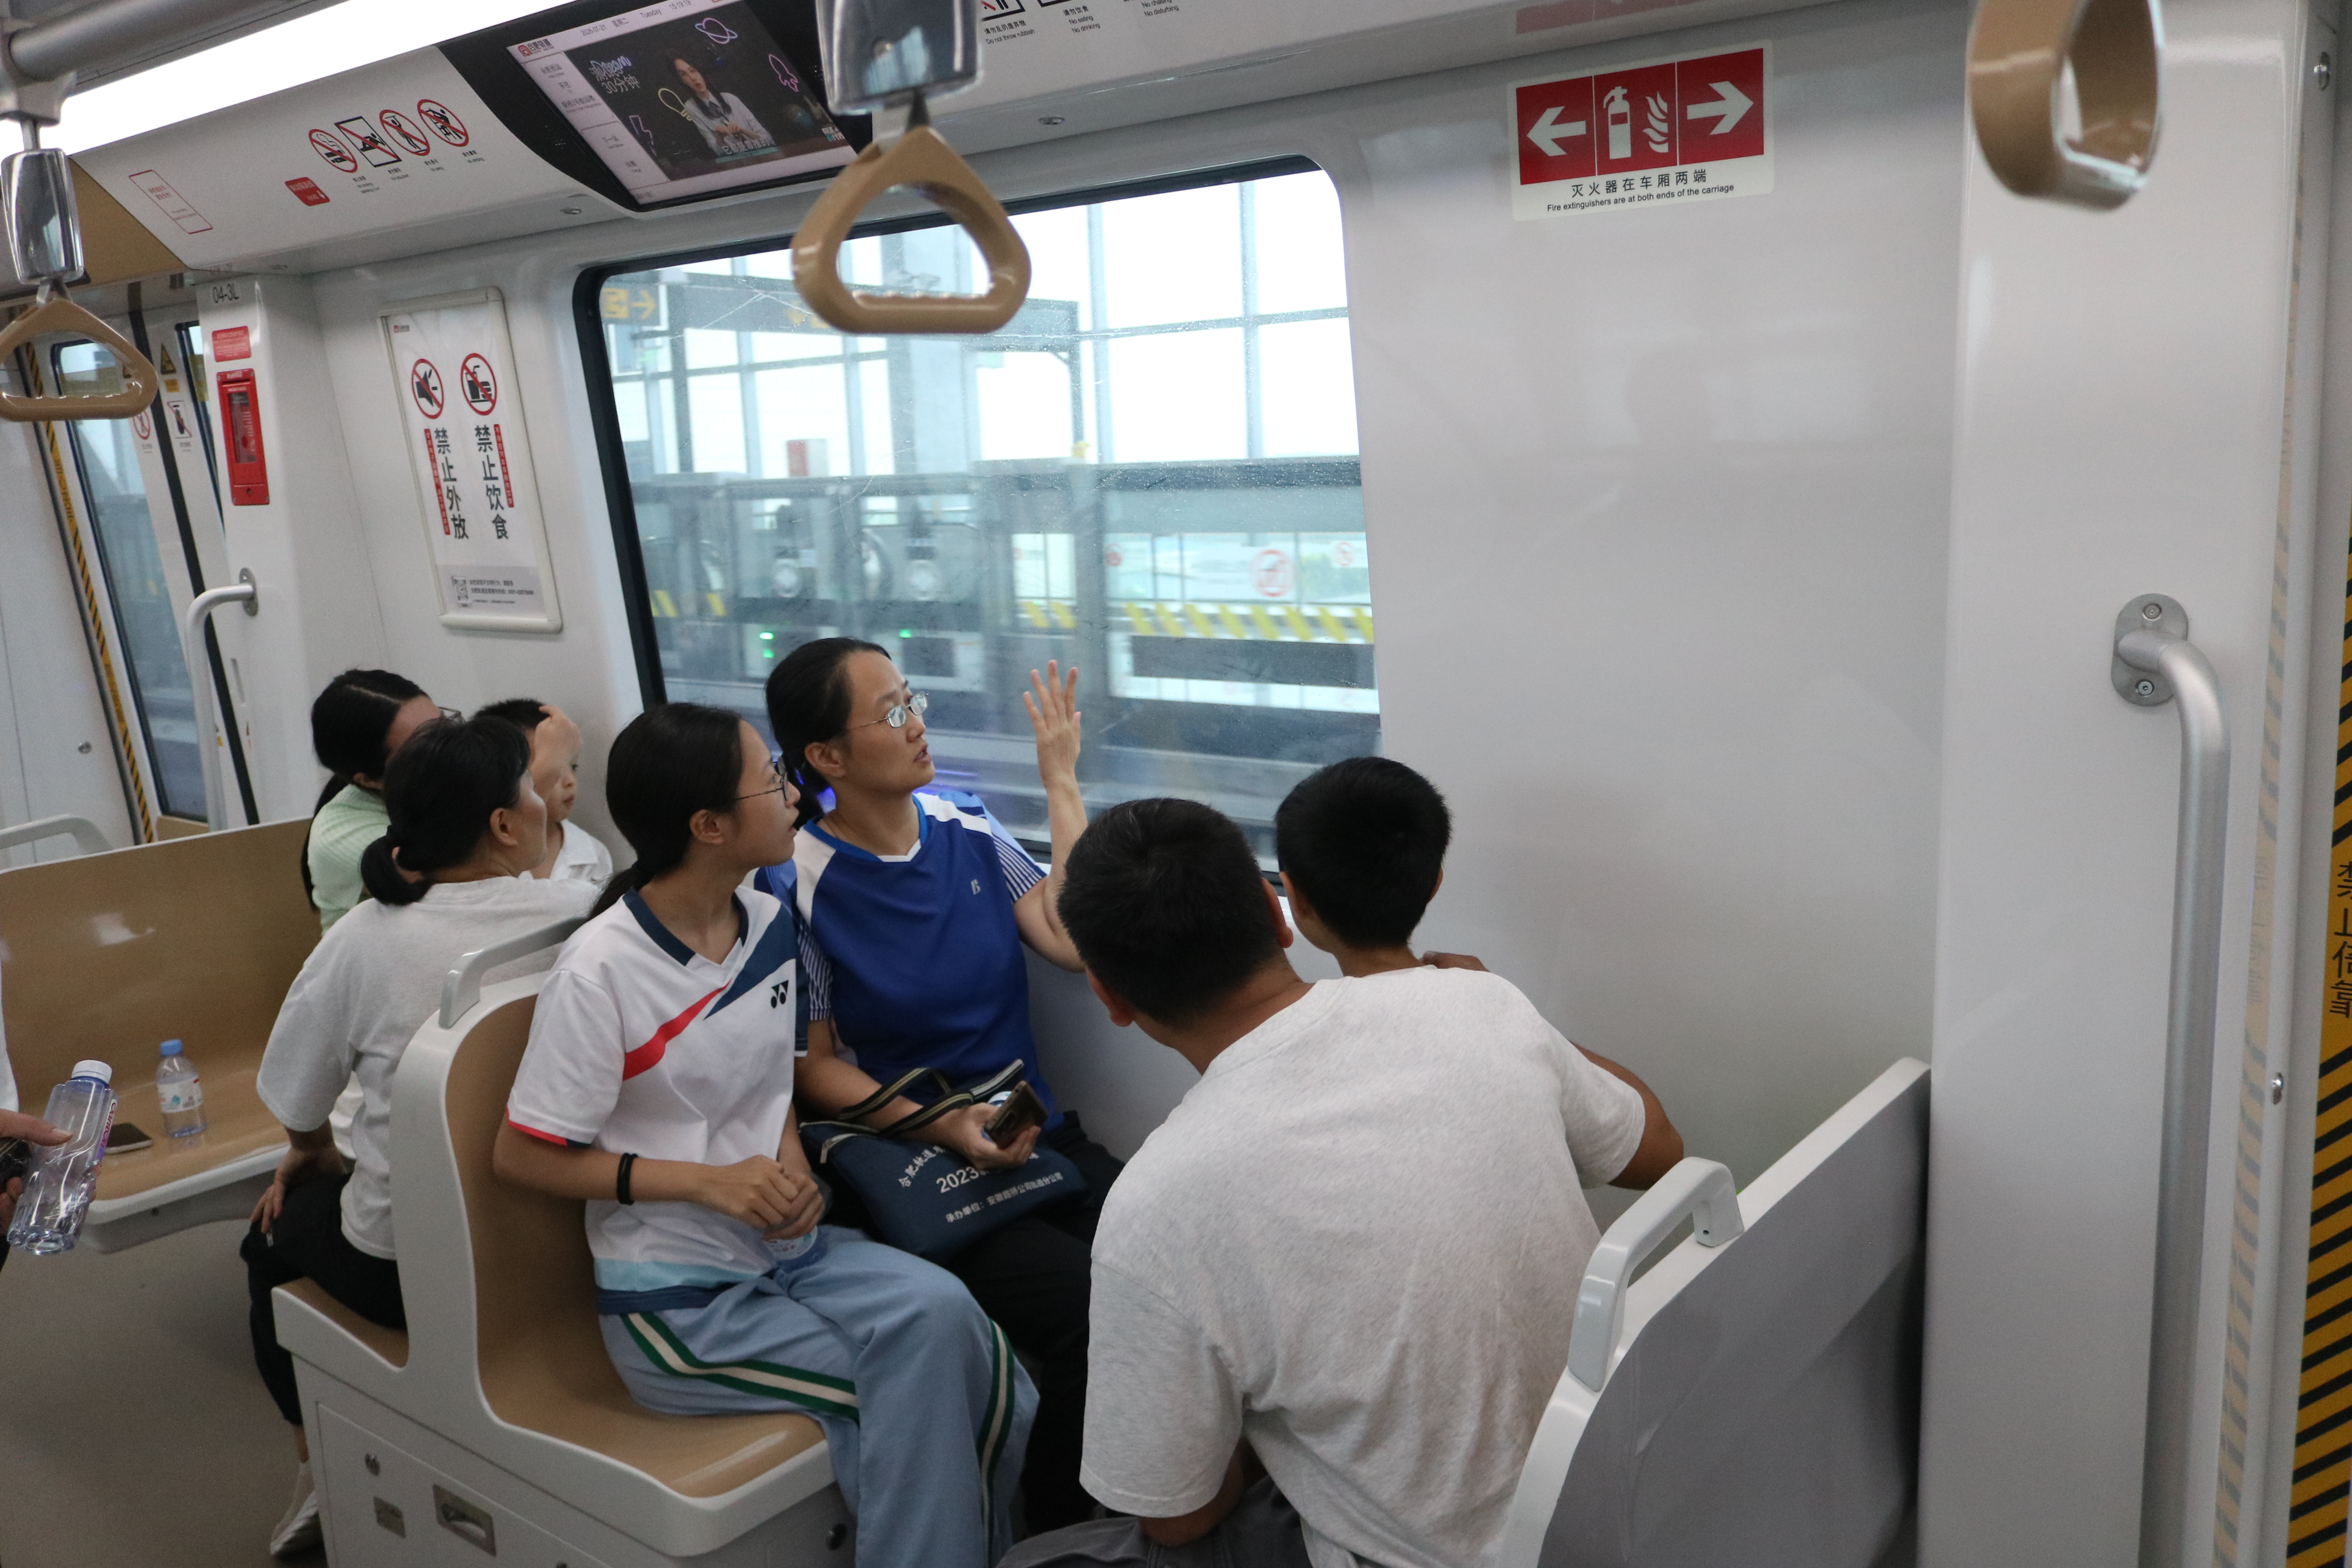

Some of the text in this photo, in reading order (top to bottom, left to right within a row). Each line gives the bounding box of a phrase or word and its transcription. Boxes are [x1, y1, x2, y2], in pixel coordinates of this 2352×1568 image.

[640, 9, 662, 19] Tuesday
[1063, 5, 1089, 16] 请勿饮食
[1154, 5, 1180, 15] disturbing
[1078, 15, 1094, 24] eating
[984, 20, 1026, 34] 请勿乱扔废弃物
[1081, 23, 1101, 31] drinking
[1003, 32, 1016, 41] throw
[1017, 29, 1035, 38] rubbish
[602, 74, 640, 94] 30分钟
[1572, 169, 1706, 198] 灭火器在车厢两端
[1563, 198, 1611, 210] extinguishers
[1638, 193, 1654, 201] both
[1656, 191, 1675, 200] ends
[1687, 188, 1699, 196] the
[1702, 185, 1734, 194] carriage
[212, 283, 240, 303] 04-3L
[434, 428, 468, 540] 禁止外放
[475, 425, 508, 540] 禁止饮食
